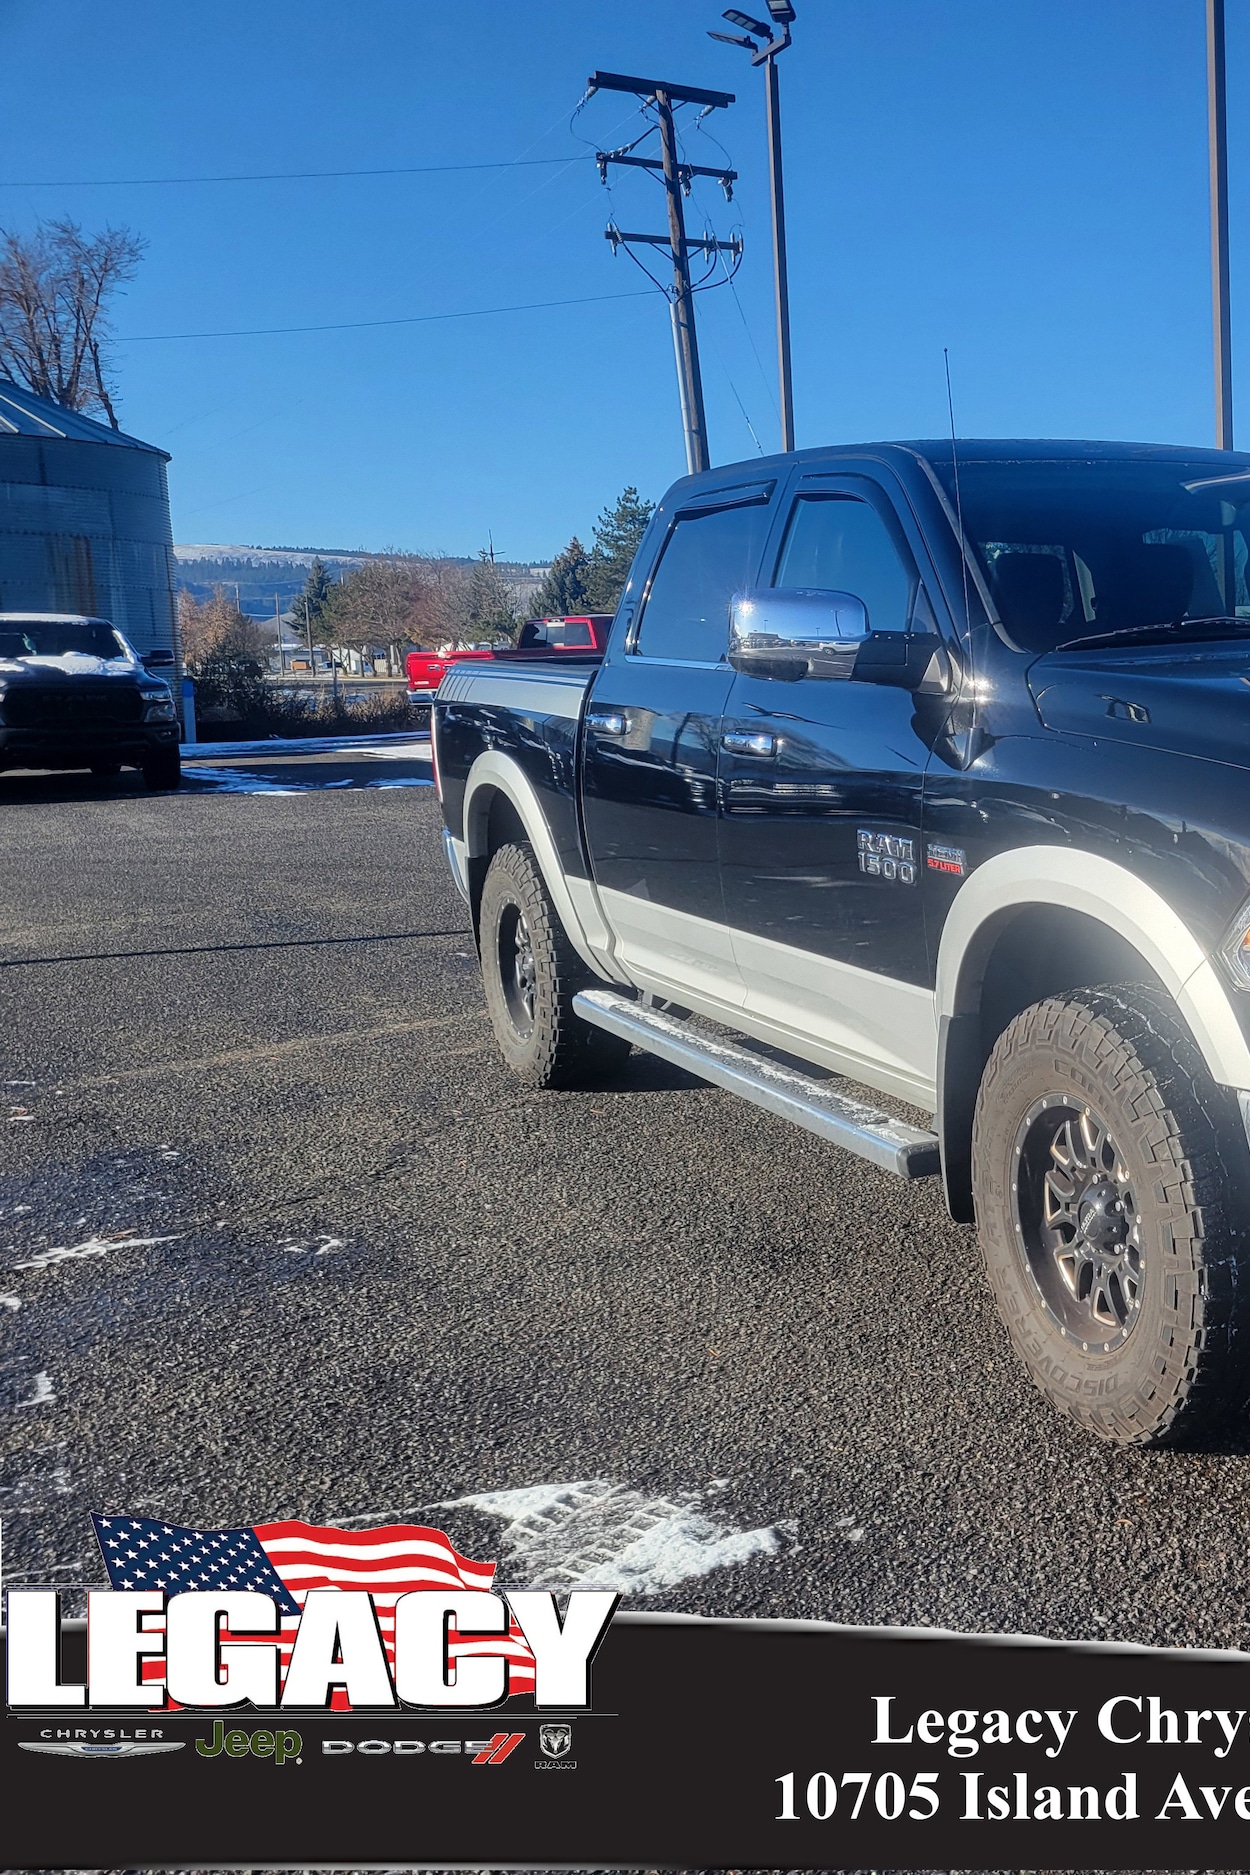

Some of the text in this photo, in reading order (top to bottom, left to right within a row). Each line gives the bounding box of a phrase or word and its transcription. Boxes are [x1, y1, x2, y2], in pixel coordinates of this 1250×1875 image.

[857, 829, 914, 860] RAM
[858, 851, 914, 884] 1500
[940, 861, 961, 873] LITER
